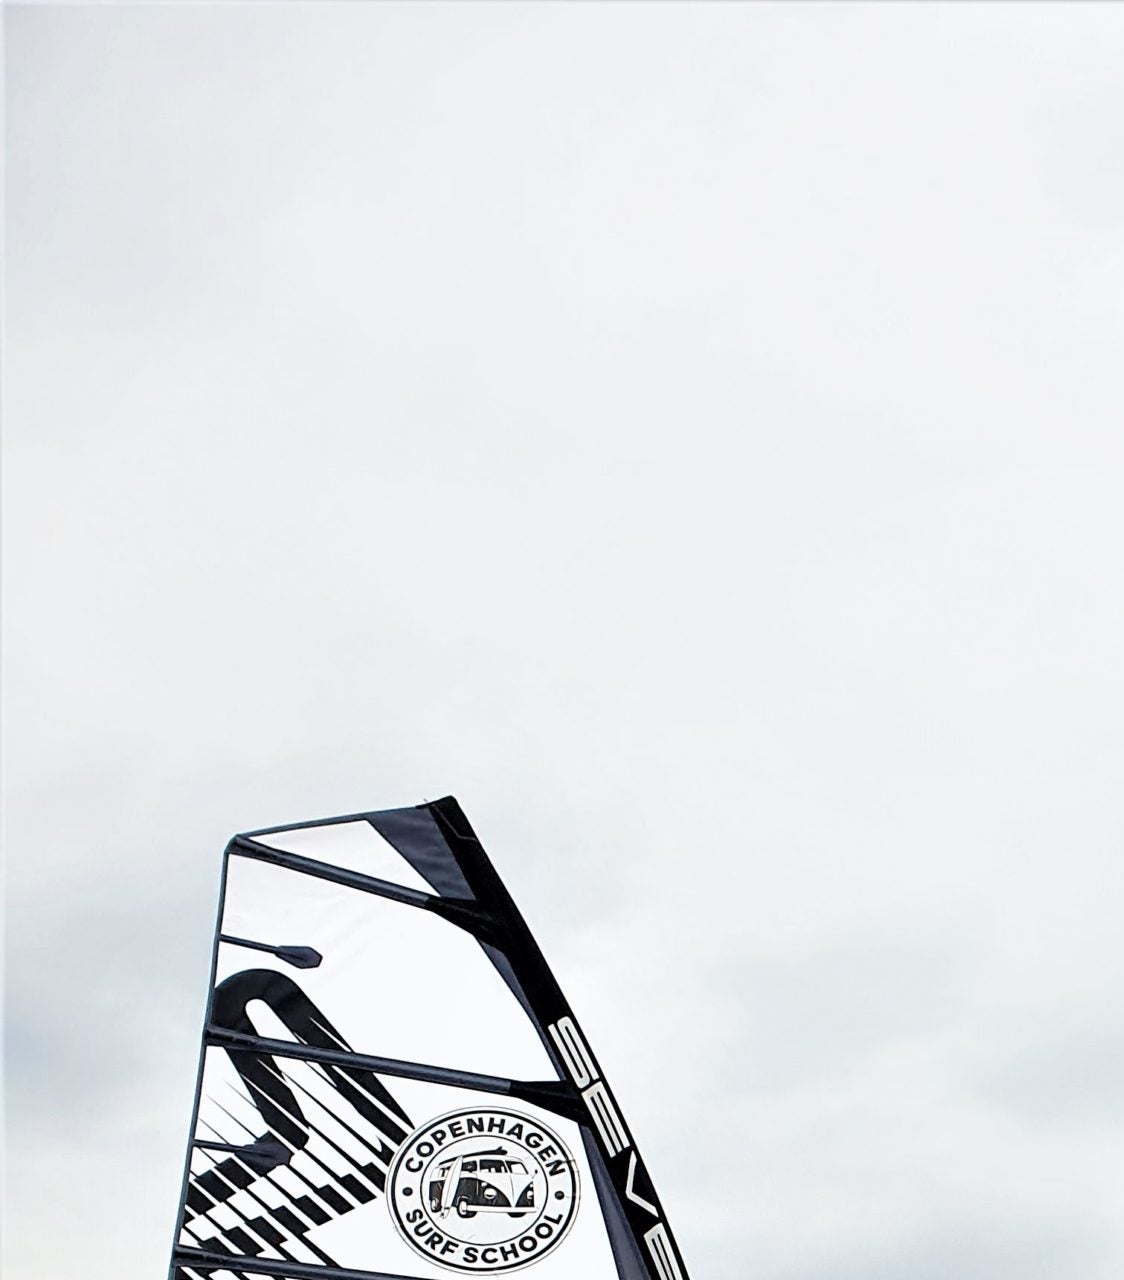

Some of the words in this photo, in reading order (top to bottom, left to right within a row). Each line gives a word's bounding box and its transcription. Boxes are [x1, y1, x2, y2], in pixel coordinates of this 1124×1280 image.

[404, 1116, 566, 1177] COPENHAGEN
[406, 1208, 460, 1257] SURF
[462, 1212, 564, 1265] SCHOOL
